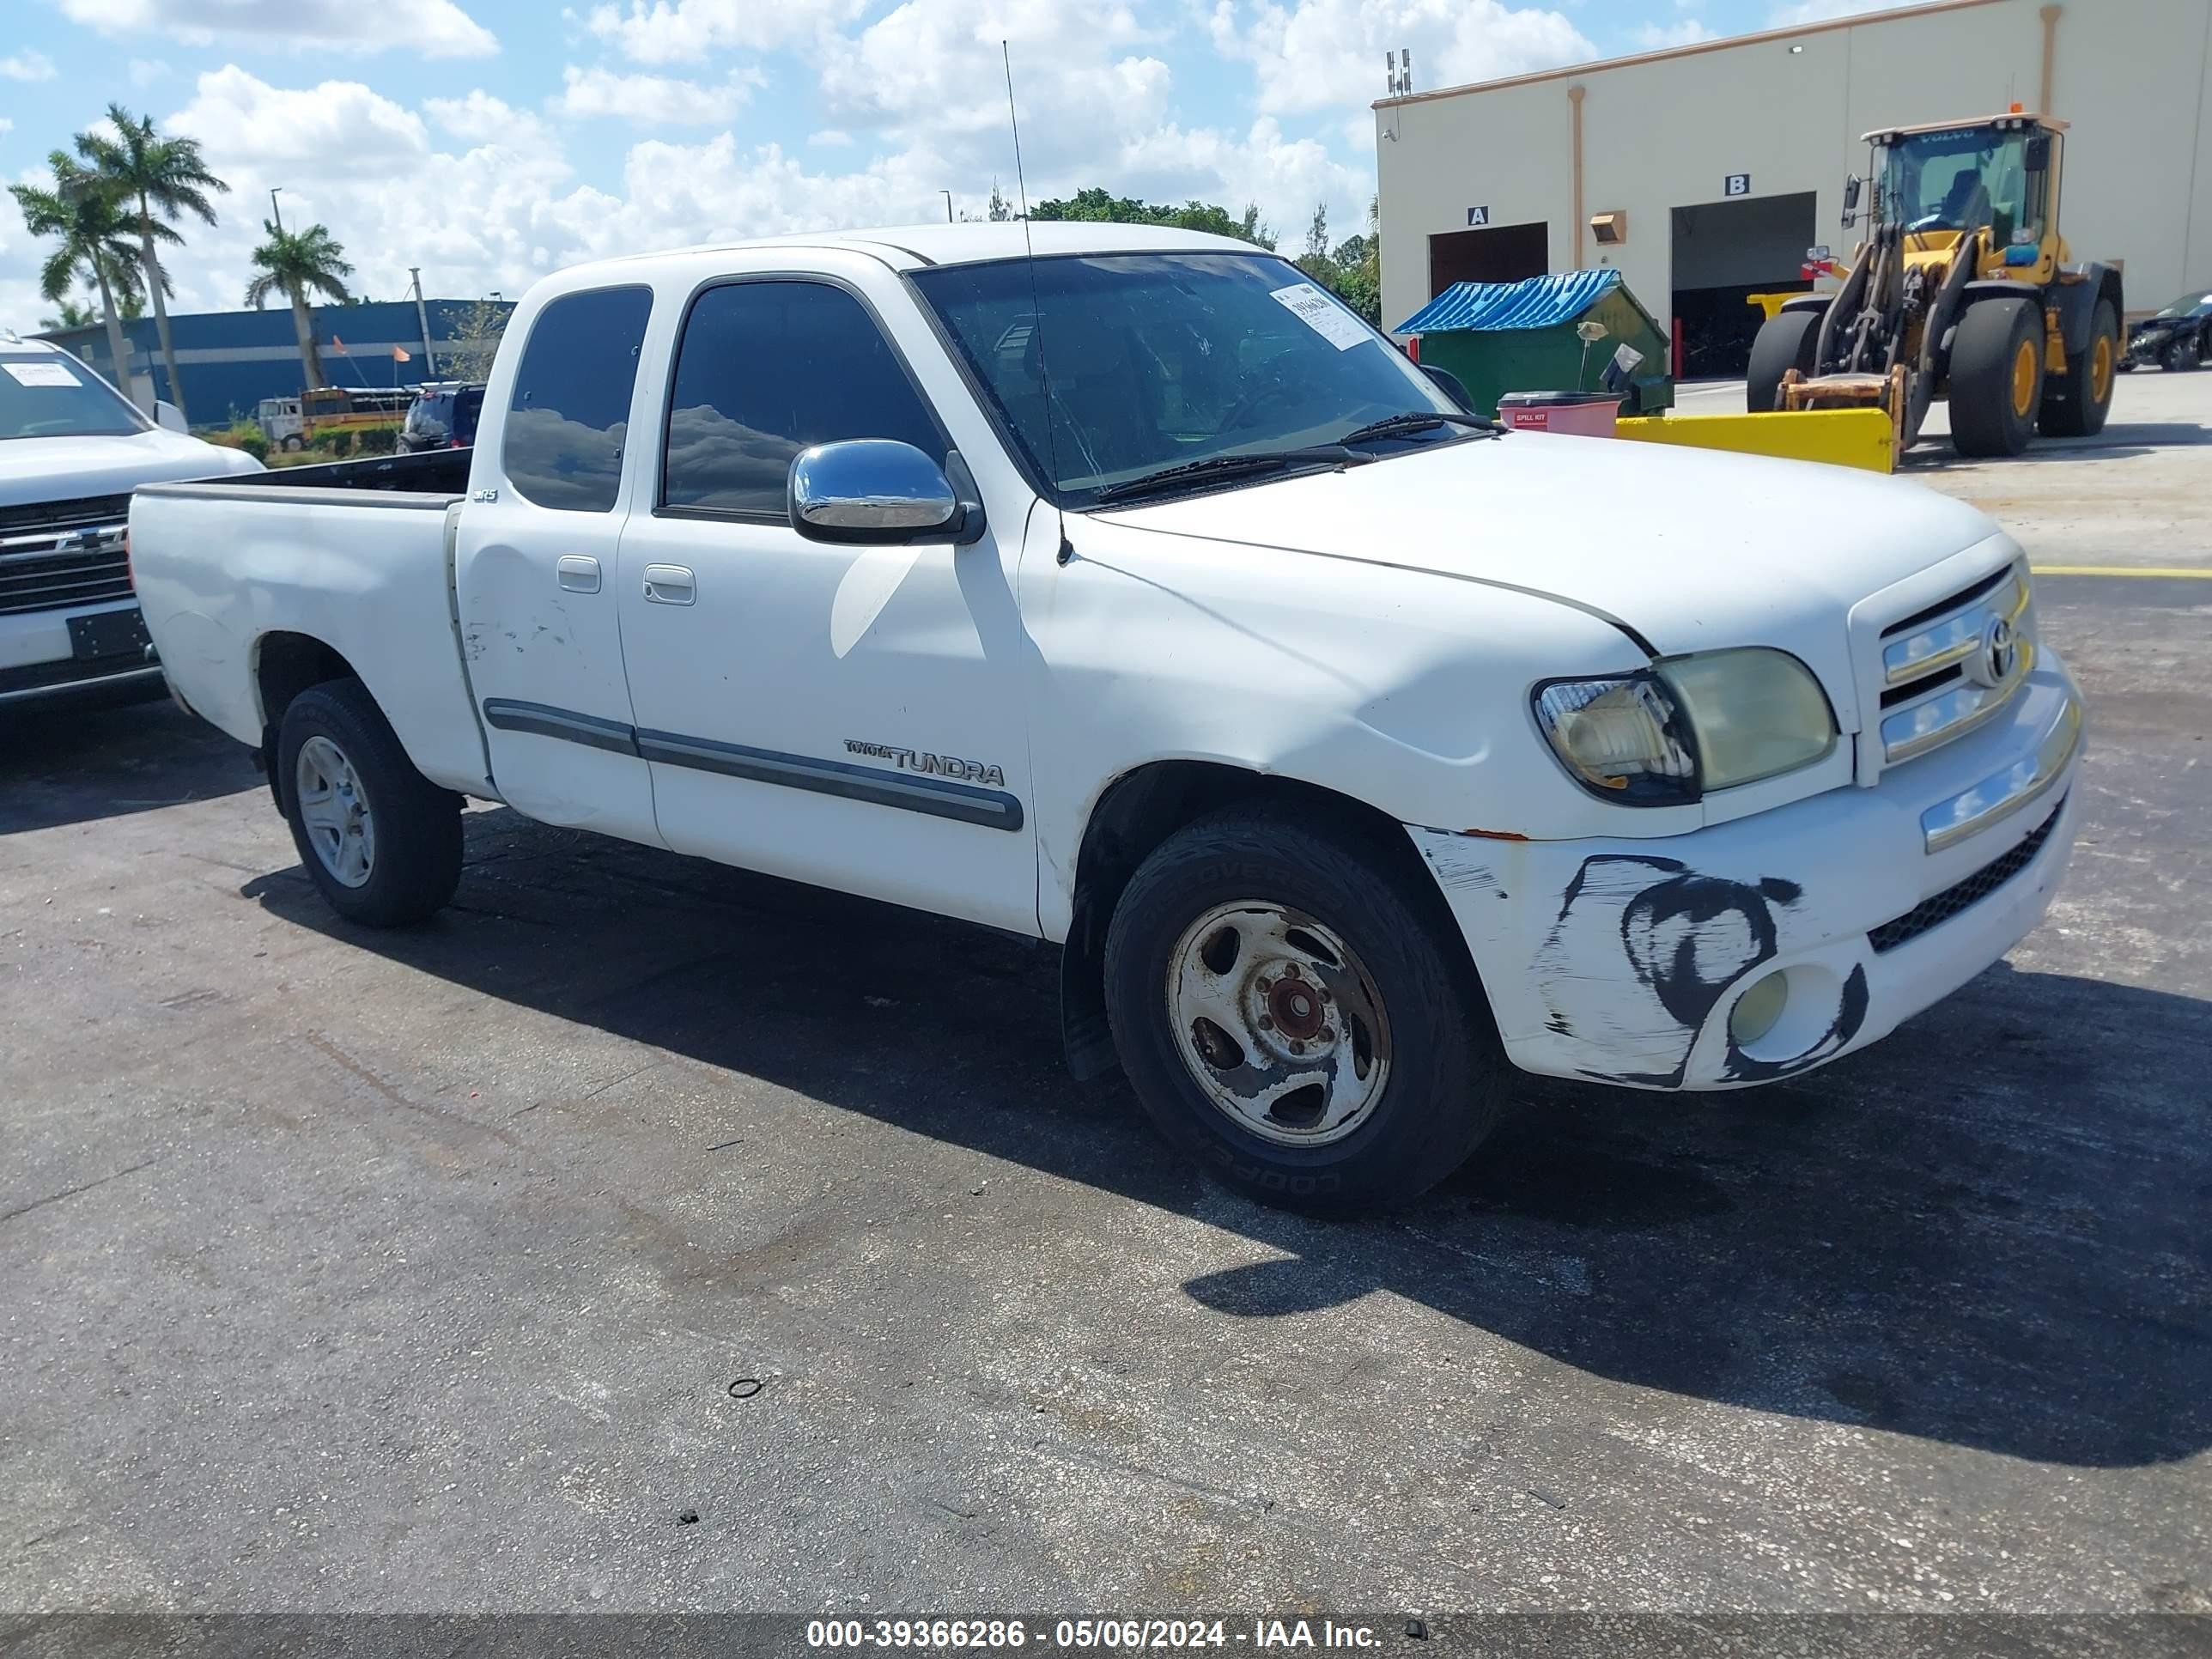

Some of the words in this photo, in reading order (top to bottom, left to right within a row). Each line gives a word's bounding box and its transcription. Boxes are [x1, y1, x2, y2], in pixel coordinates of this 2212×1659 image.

[1729, 175, 1746, 195] B
[1470, 208, 1486, 225] A
[844, 739, 894, 759] TOYOTA
[891, 747, 1006, 787] TUNDRA
